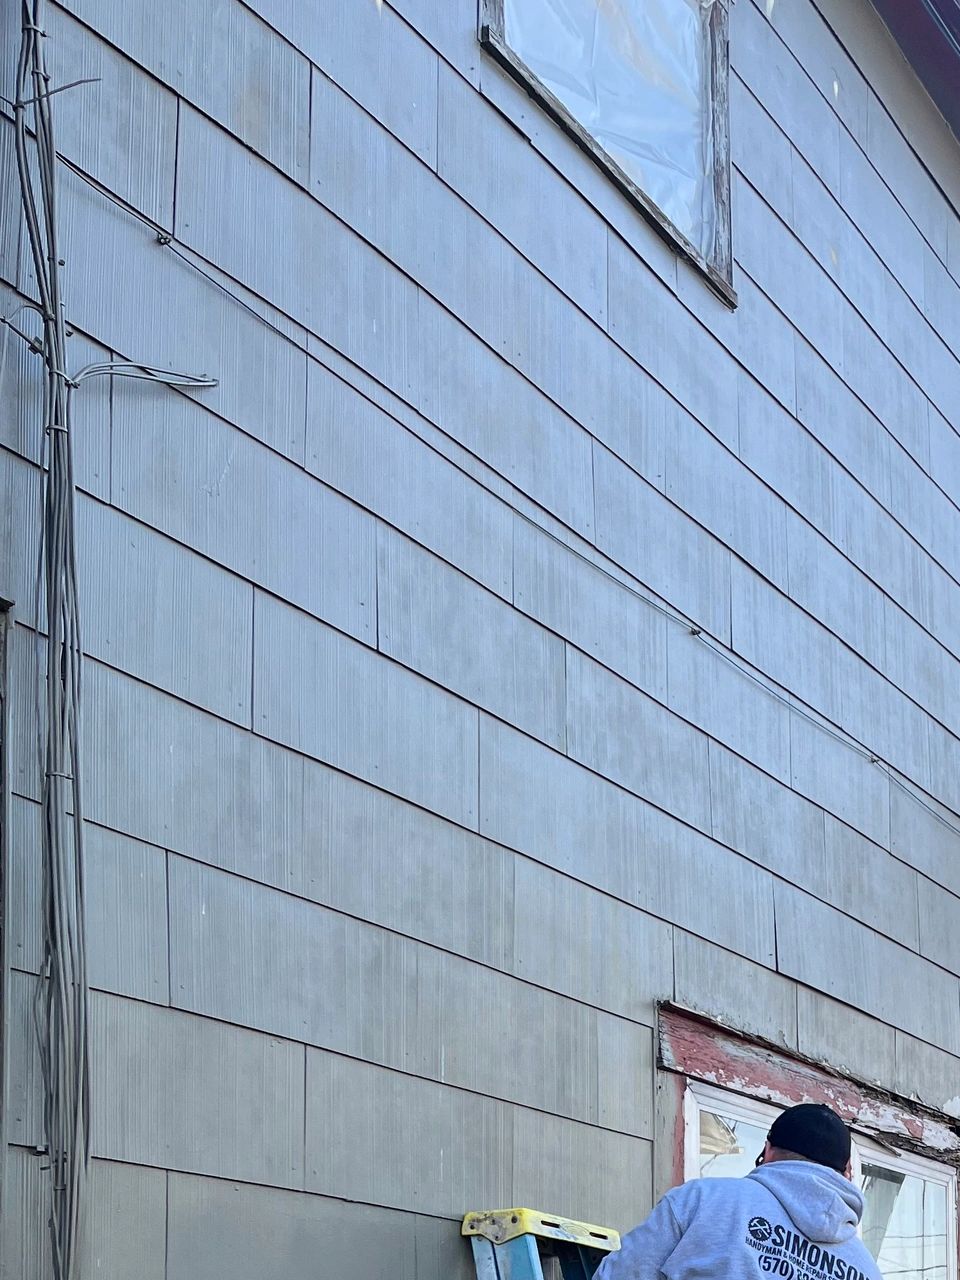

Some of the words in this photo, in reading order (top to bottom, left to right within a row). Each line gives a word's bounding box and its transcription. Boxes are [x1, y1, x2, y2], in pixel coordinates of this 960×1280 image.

[745, 1236, 782, 1257] HANDYMAN
[788, 1254, 805, 1270] HOME
[805, 1264, 827, 1280] REPAIR
[758, 1255, 794, 1280] (570)
